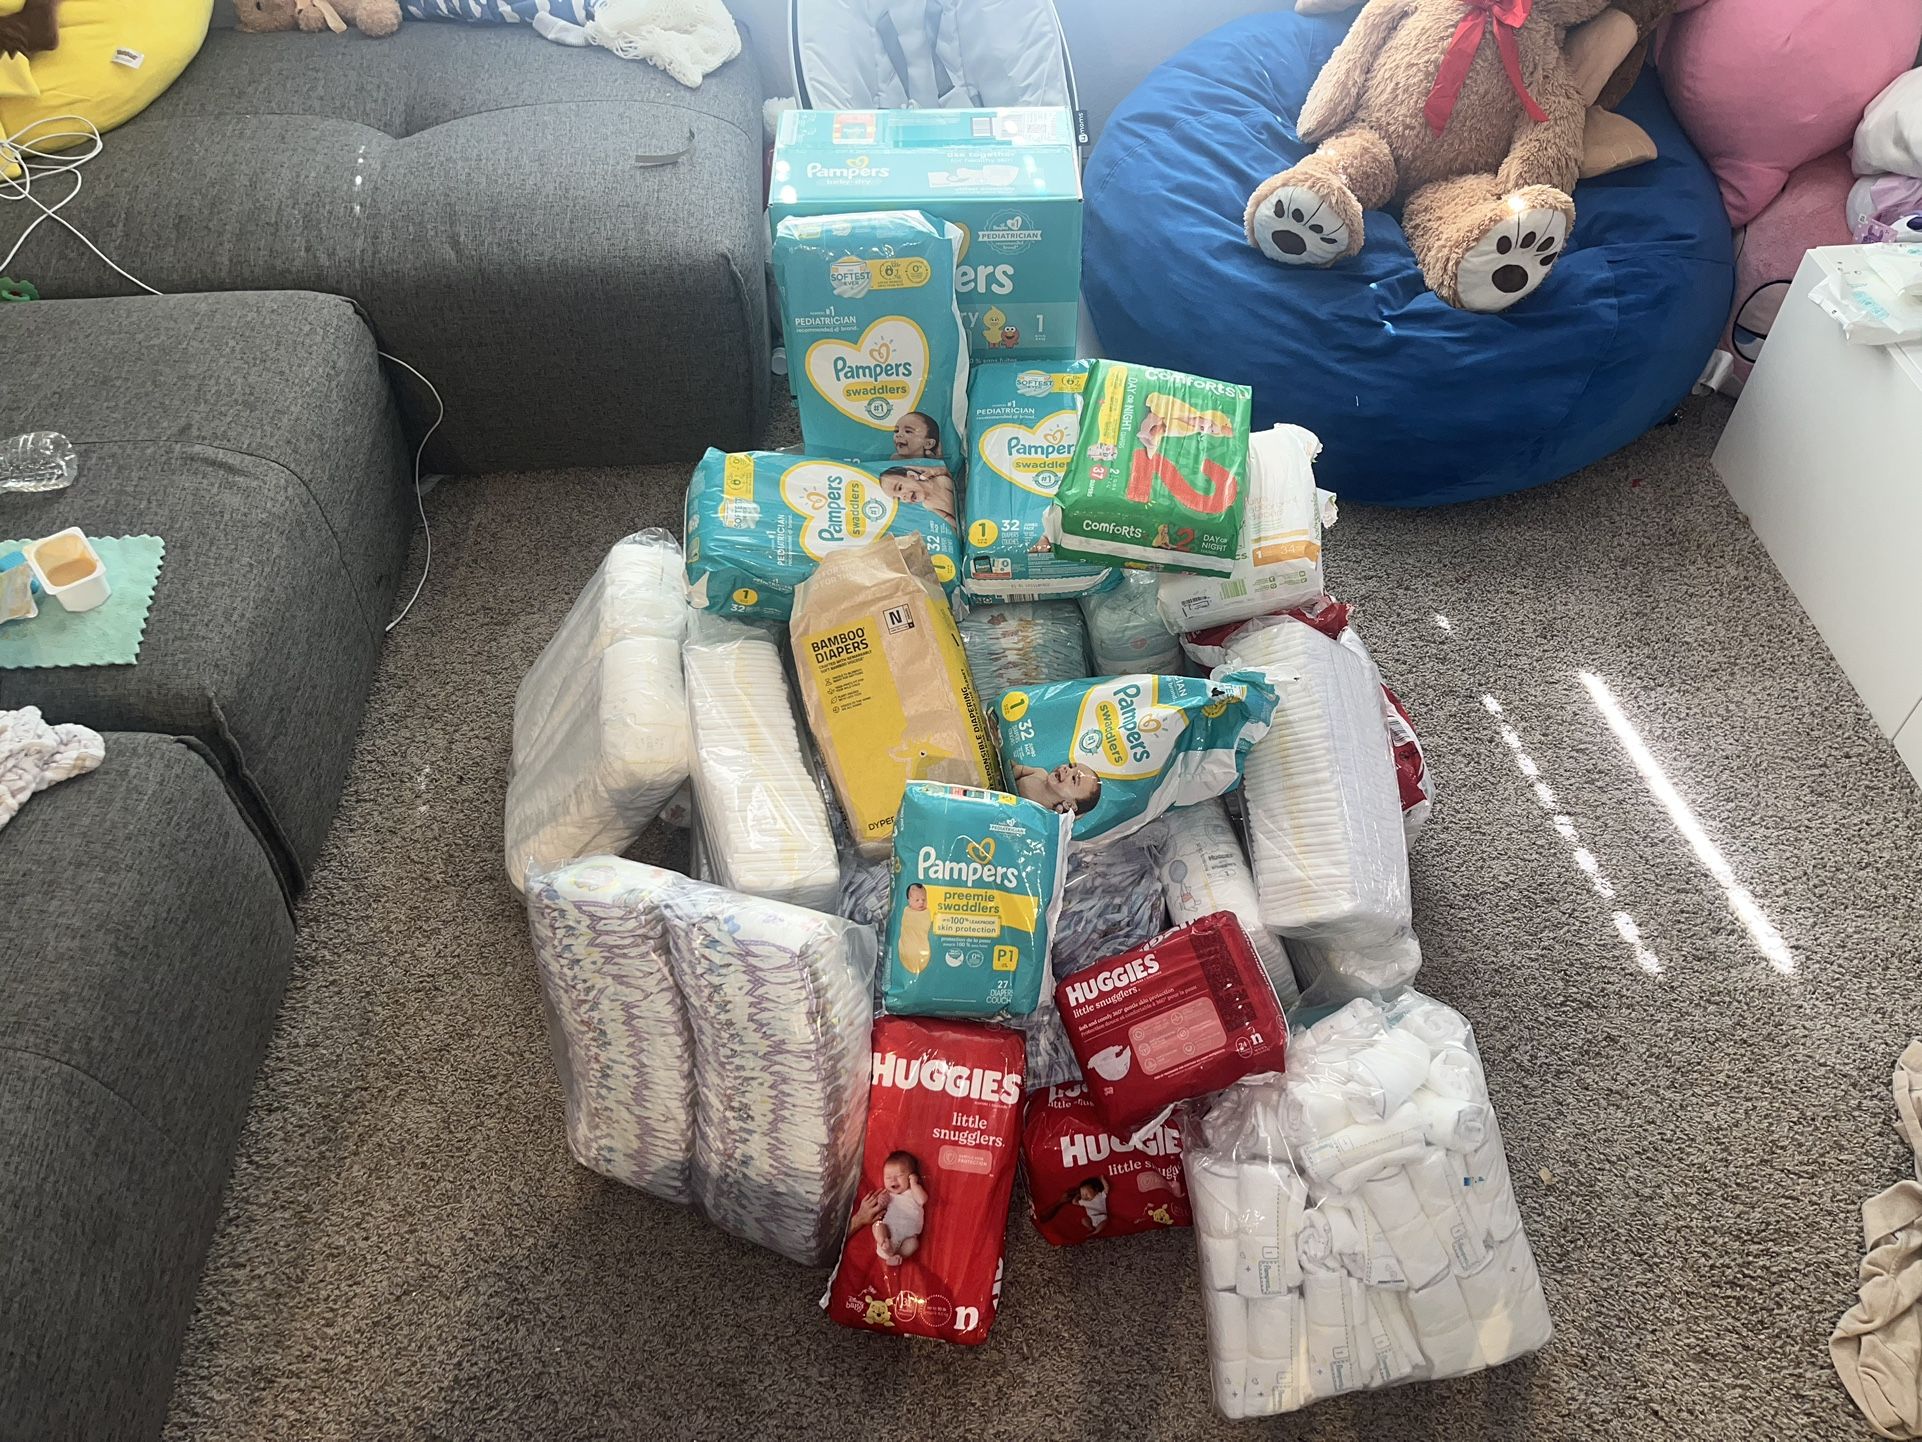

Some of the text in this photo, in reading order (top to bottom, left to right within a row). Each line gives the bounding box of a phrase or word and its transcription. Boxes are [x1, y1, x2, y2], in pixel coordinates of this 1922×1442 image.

[807, 162, 890, 179] Pampers
[981, 232, 1040, 240] PEDIATRICIAN
[831, 271, 871, 282] SOFTEST
[795, 316, 857, 326] PEDIATRICIAN
[1036, 314, 1044, 333] 1
[833, 356, 912, 382] Pampers
[846, 382, 907, 397] swaddlers
[1128, 376, 1138, 395] DAY
[873, 403, 885, 413] #1
[976, 407, 1035, 415] PEDIATRICIAN
[1007, 400, 1016, 408] #1
[1121, 405, 1133, 432] NIGHT
[1008, 437, 1074, 459] Pamper
[1041, 475, 1053, 483] #1
[1092, 466, 1105, 480] 37
[818, 475, 847, 542] Pampers
[851, 482, 861, 536] swaddlers
[870, 506, 878, 516] #1
[978, 523, 987, 537] 1
[1001, 520, 1020, 531] 32
[776, 514, 786, 566] PEDIATRICIAN
[927, 535, 941, 552] 32
[1176, 528, 1196, 552] 2
[1203, 534, 1220, 543] DAY
[1202, 542, 1228, 552] NIGHT
[1256, 550, 1262, 559] 1
[1280, 545, 1295, 555] 34
[730, 603, 746, 613] 32
[888, 610, 902, 626] N
[811, 627, 865, 653] BAMBOO
[815, 638, 869, 664] DIAPERS
[961, 686, 980, 734] DIAPERING
[1012, 698, 1025, 711] 1
[1018, 718, 1035, 740] 32
[1112, 683, 1151, 764] Pampers
[1099, 703, 1123, 764] swaddlers
[1084, 736, 1095, 749] #1
[991, 826, 1025, 834] PEDIATRICIAN
[918, 846, 1019, 888] Pampers
[944, 891, 995, 902] preemie
[937, 901, 1000, 914] swaddlers
[955, 925, 997, 934] protection
[997, 981, 1008, 989] 27
[1064, 953, 1161, 1008] HUGGIES
[1073, 1003, 1095, 1019] little
[1078, 1022, 1089, 1032] Soft
[1088, 1019, 1098, 1028] and
[1097, 1013, 1112, 1025] comfy
[1123, 1002, 1138, 1014] gentle
[1138, 998, 1149, 1007] skin
[1148, 987, 1175, 1004] protection
[1080, 1024, 1101, 1037] Protection
[1100, 1019, 1114, 1028] douce
[1167, 994, 1178, 1004] pour
[1250, 1032, 1264, 1046] n
[871, 1052, 1022, 1105] HUGGIES
[952, 1112, 988, 1130] little
[957, 1159, 988, 1167] PROTECTION
[1107, 1159, 1142, 1176] little
[845, 1302, 866, 1313] baby
[953, 1305, 979, 1331] n
